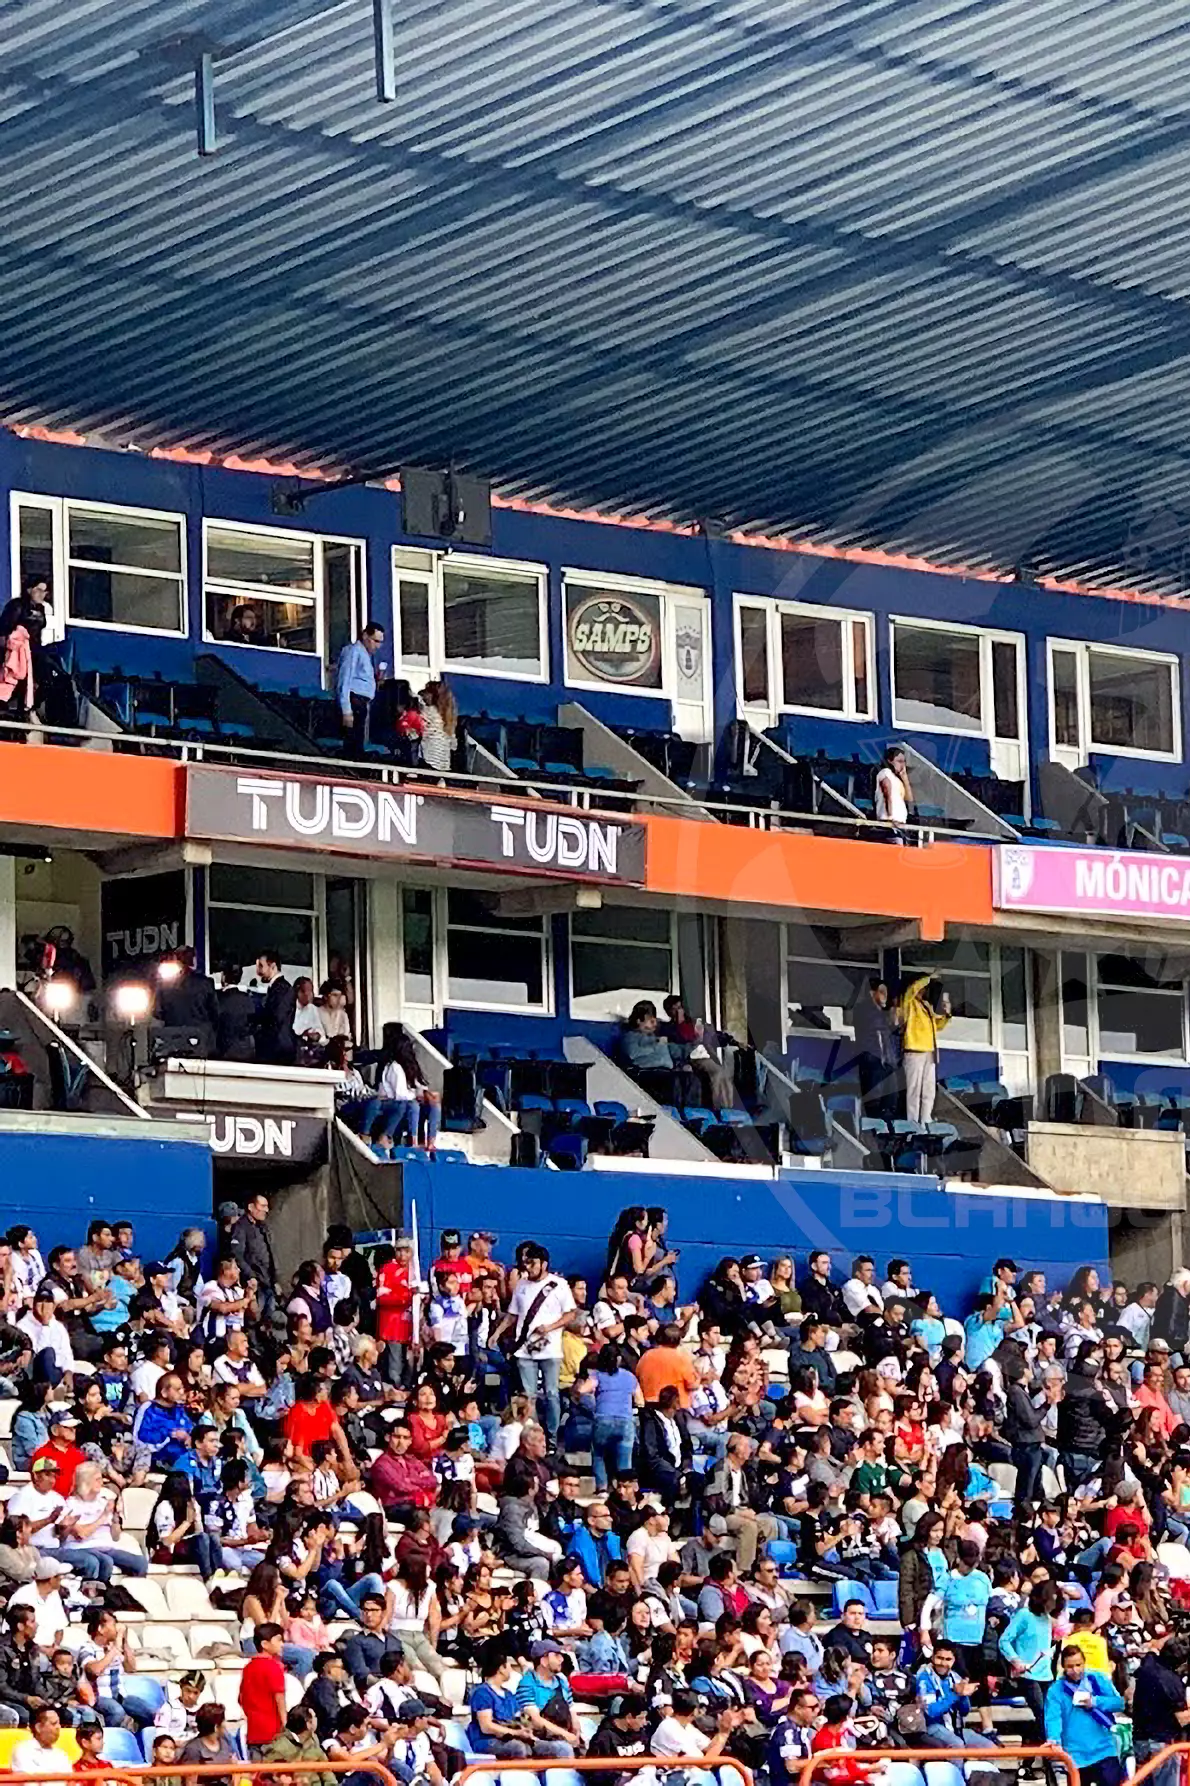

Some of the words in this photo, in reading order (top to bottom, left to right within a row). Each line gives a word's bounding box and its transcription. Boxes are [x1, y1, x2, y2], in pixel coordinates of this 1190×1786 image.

[574, 622, 652, 653] SAMPS
[236, 777, 418, 845] TUDN
[490, 805, 618, 873] TUDN
[106, 921, 180, 959] TUDN
